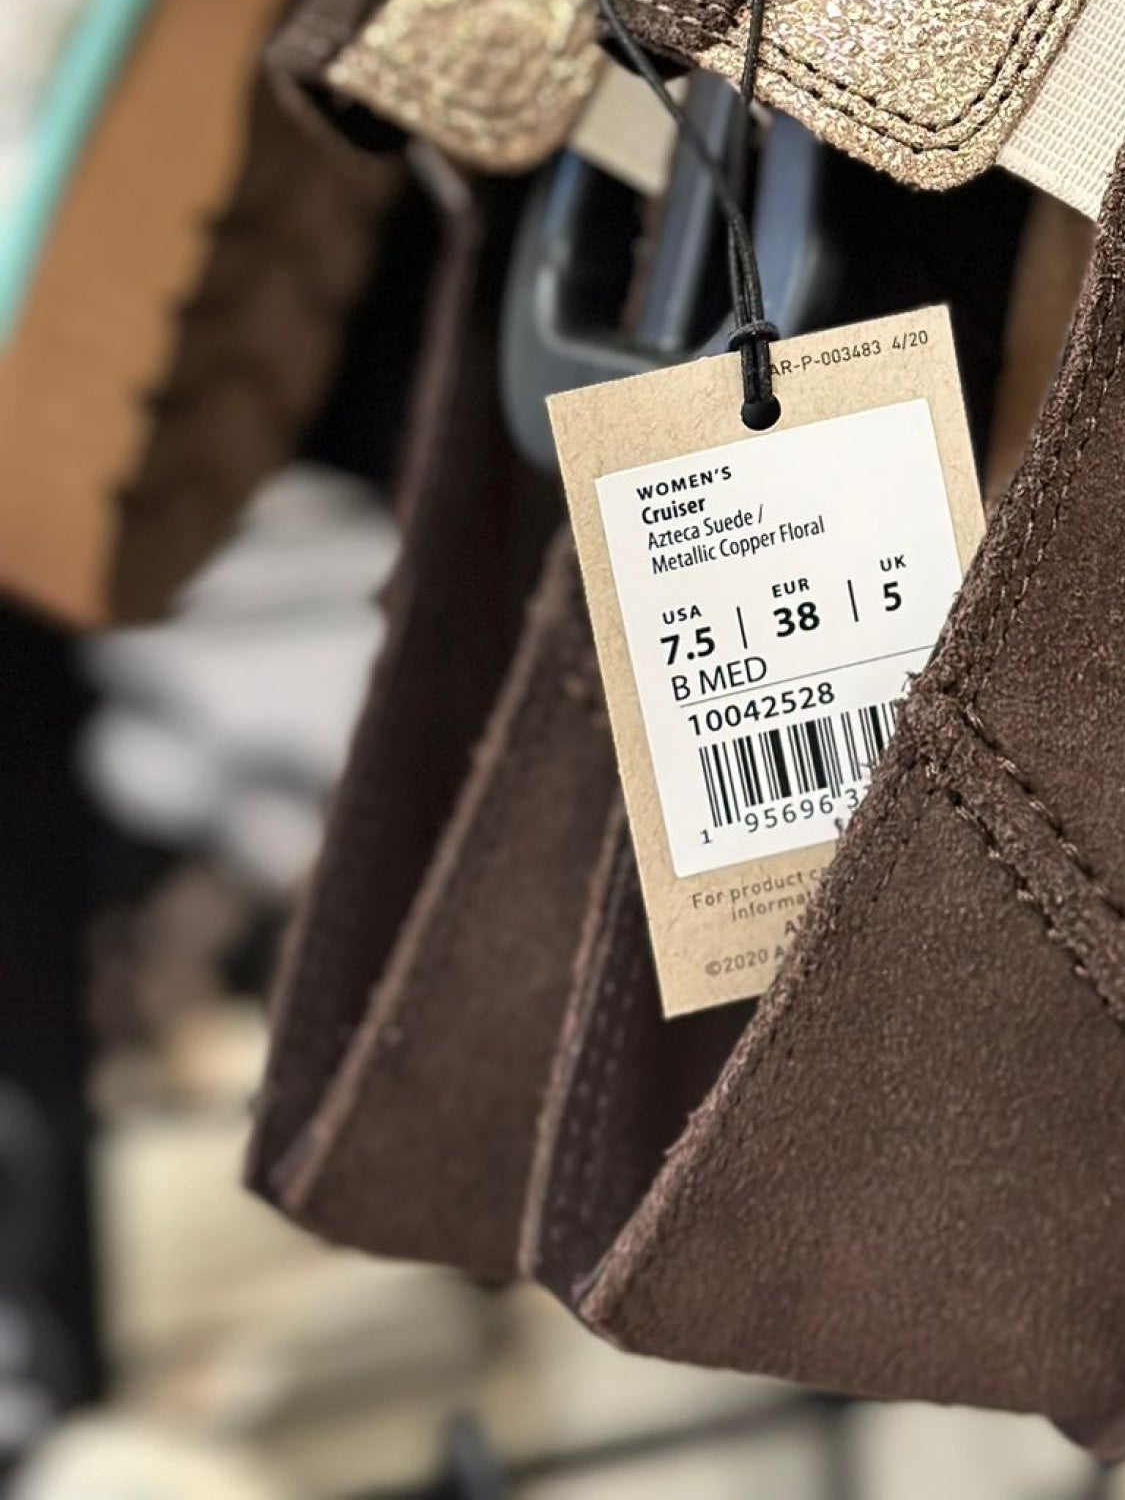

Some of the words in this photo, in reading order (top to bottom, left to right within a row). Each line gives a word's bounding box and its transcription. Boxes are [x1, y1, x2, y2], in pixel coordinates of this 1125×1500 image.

[891, 330, 929, 351] 4/20
[636, 465, 733, 501] WOMEN'S
[641, 497, 706, 525] Cruiser
[648, 524, 700, 551] Azteca
[703, 509, 754, 537] Suede
[652, 544, 718, 575] Metallic
[720, 531, 777, 558] Copper
[779, 515, 826, 543] Floral
[662, 605, 703, 625] USA
[771, 578, 811, 599] EUR
[879, 555, 907, 572] UK
[660, 626, 716, 666] 7.5
[773, 601, 820, 638] 38
[882, 581, 902, 612] 5
[671, 674, 691, 702] B
[699, 656, 768, 696] MED
[687, 681, 836, 736] 10042528
[700, 828, 713, 845] 1
[744, 794, 834, 833] 95696
[692, 891, 724, 910] For
[730, 870, 804, 906] product
